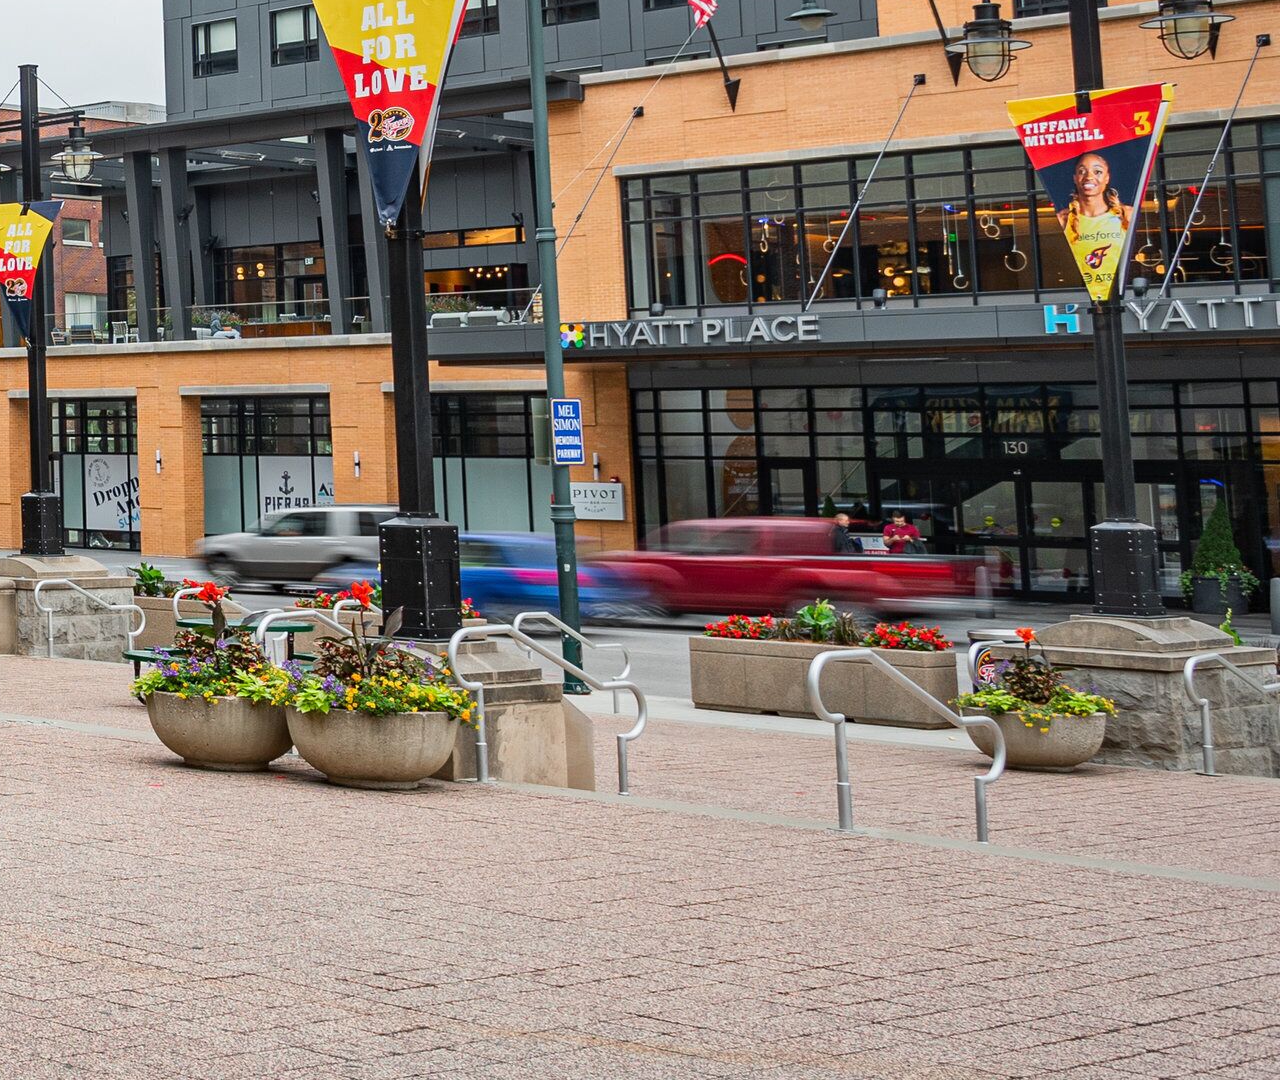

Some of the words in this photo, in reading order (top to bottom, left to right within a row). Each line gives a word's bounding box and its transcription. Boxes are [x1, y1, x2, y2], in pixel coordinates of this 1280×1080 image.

[360, 0, 415, 32] ALL
[361, 33, 418, 65] FOR
[354, 65, 428, 99] LOVE
[1022, 117, 1087, 135] TIFFANY
[1133, 111, 1151, 136] 3
[1023, 128, 1105, 148] MITCHELL
[6, 222, 33, 238] ALL
[1077, 230, 1121, 243] alesforce
[3, 239, 32, 255] FOR
[1126, 296, 1263, 332] YATT
[589, 319, 694, 347] HYATT
[701, 314, 821, 344] PLACE
[557, 404, 576, 417] MEL
[554, 418, 581, 431] SIMON
[555, 435, 582, 446] MEMORIAL
[1002, 440, 1028, 455] 130
[556, 448, 581, 460] PARKWAY
[572, 489, 617, 500] PIVOT
